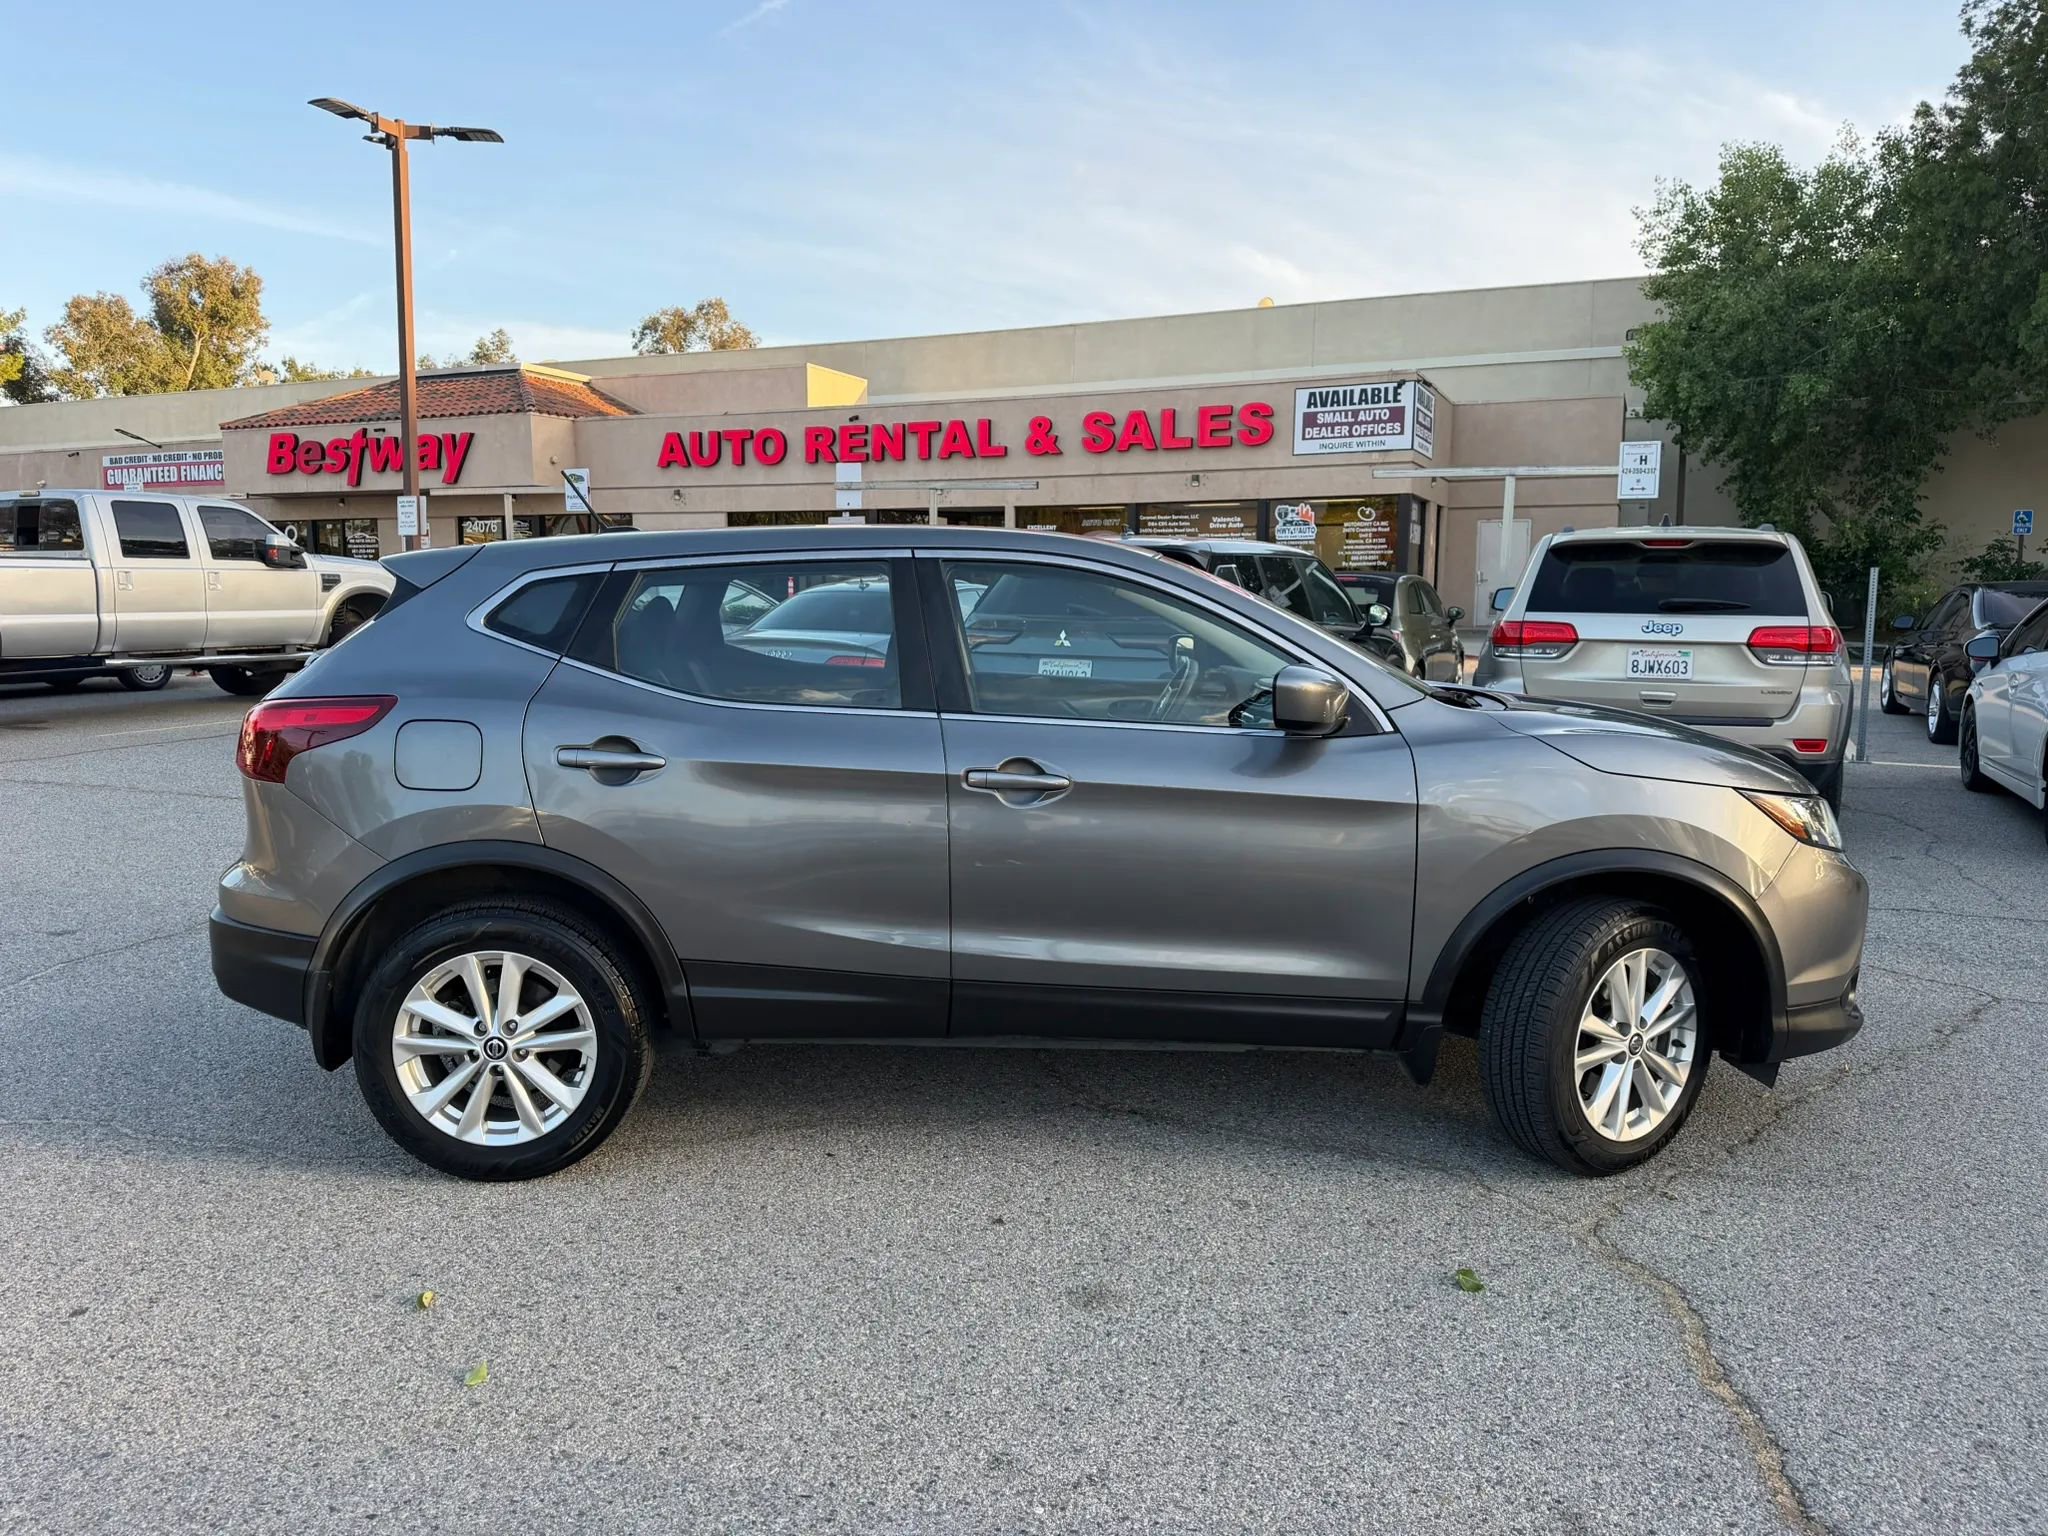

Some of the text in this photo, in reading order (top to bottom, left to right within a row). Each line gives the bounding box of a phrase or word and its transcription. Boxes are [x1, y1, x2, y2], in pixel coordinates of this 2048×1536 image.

[1306, 386, 1402, 409] AVAILABLE
[1317, 409, 1390, 424] SMALL AUTO
[657, 402, 1275, 468] AUTO RENTAL & SALES
[1304, 425, 1350, 439] DEALER
[1352, 422, 1401, 436] OFFICES
[1319, 440, 1386, 450] INQUIRE WITHIN
[109, 451, 223, 465] BAD CREDIT NO CREDIT NO PROB
[267, 428, 475, 487] Bestway
[107, 466, 178, 485] GUARANTEED
[467, 520, 498, 533] 24076
[1641, 620, 1684, 636] Jeep
[1631, 659, 1689, 675] 8JWX603
